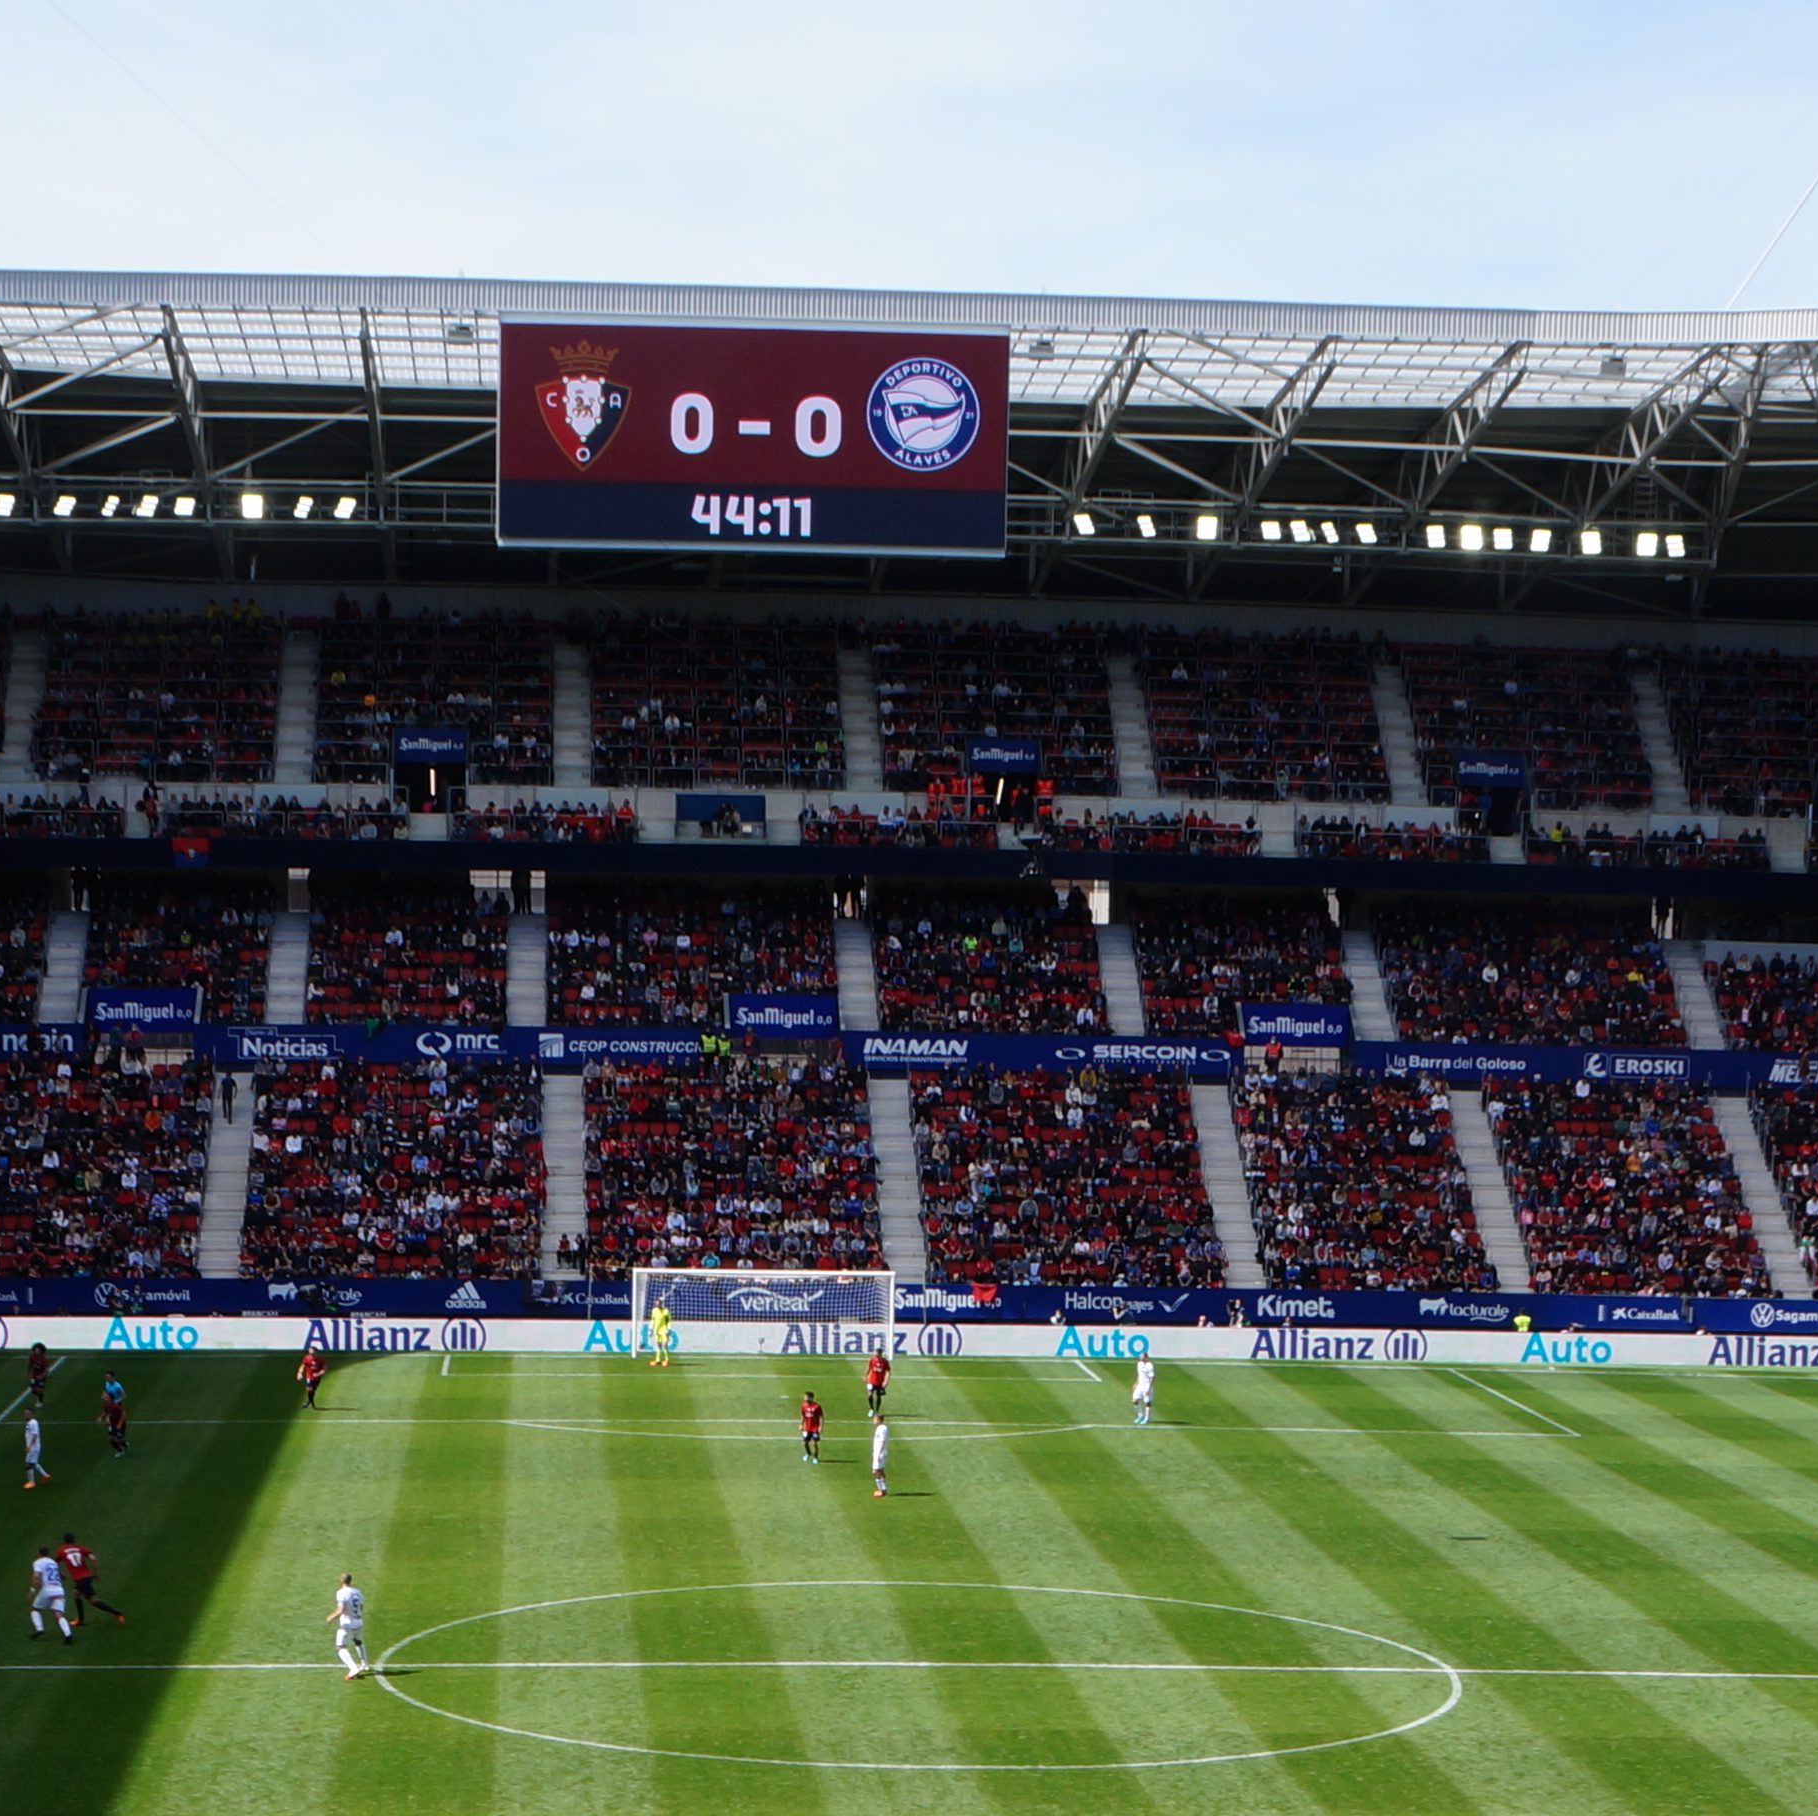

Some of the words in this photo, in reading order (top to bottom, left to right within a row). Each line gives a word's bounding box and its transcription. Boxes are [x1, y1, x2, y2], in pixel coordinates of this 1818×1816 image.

[884, 362, 963, 388] DEPORTIVO
[669, 392, 715, 455] 0
[794, 394, 842, 457] 0
[690, 493, 813, 537] 44:11
[93, 1001, 174, 1023] SanMiguel
[734, 1006, 815, 1029] SanMiguel
[1246, 1015, 1325, 1038] SanMiguel
[242, 1036, 329, 1057] Noticias
[455, 1033, 500, 1050] mrc
[568, 1039, 608, 1054] CEOP
[862, 1037, 969, 1056] INAMAN
[1092, 1044, 1197, 1060] SERCOIN
[1393, 1053, 1407, 1068] la
[1408, 1054, 1451, 1069] Barra
[1452, 1056, 1473, 1069] del
[1475, 1056, 1526, 1071] Goloso
[1614, 1058, 1685, 1075] EROSKI
[444, 1299, 487, 1310] adidas
[574, 1292, 631, 1306] CaixaBank
[1256, 1293, 1333, 1318] Kimet
[1627, 1307, 1680, 1321] CaixaBank
[103, 1315, 199, 1350] Auto
[303, 1318, 432, 1351] Allianz
[781, 1323, 908, 1354] Allianz
[1056, 1325, 1149, 1357] Auto
[1250, 1327, 1374, 1360] Allianz
[1520, 1331, 1611, 1363] Auto
